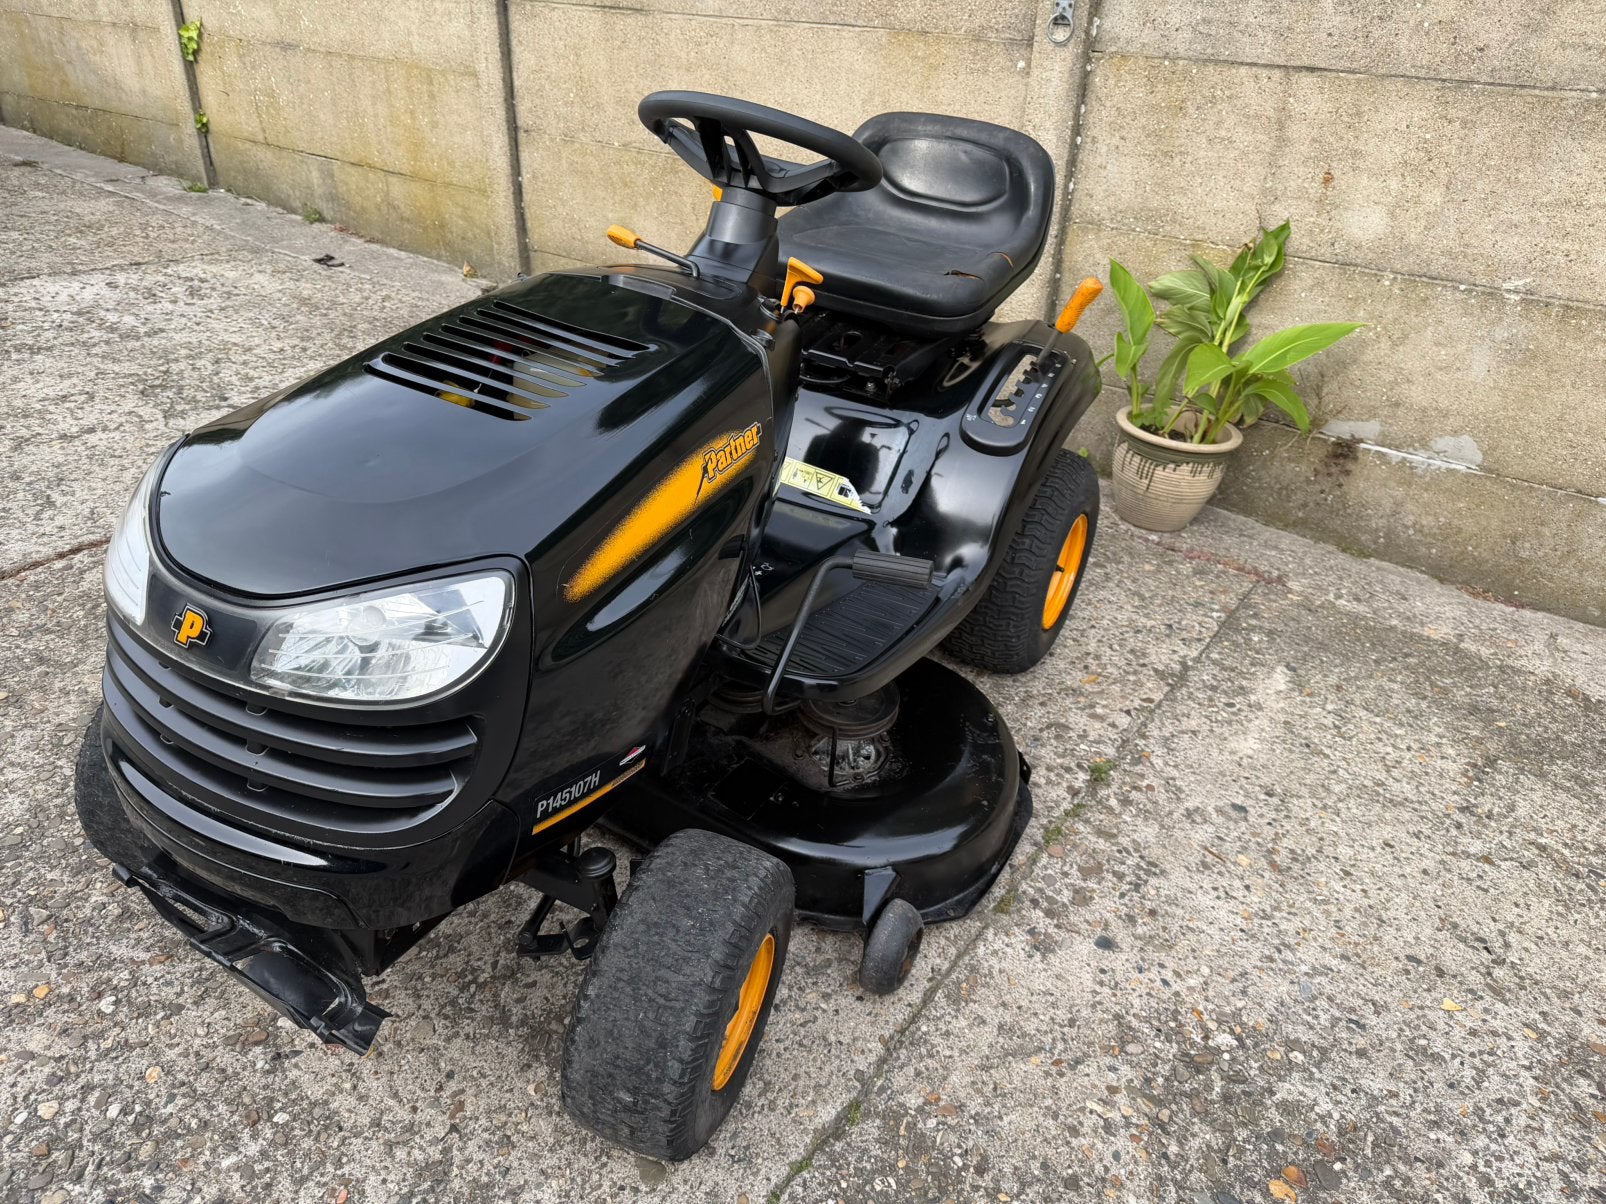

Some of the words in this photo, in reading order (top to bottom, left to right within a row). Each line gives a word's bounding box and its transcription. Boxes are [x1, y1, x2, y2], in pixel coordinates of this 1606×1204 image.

[703, 423, 761, 481] Partner
[175, 608, 206, 646] P
[536, 770, 601, 819] P145107H
